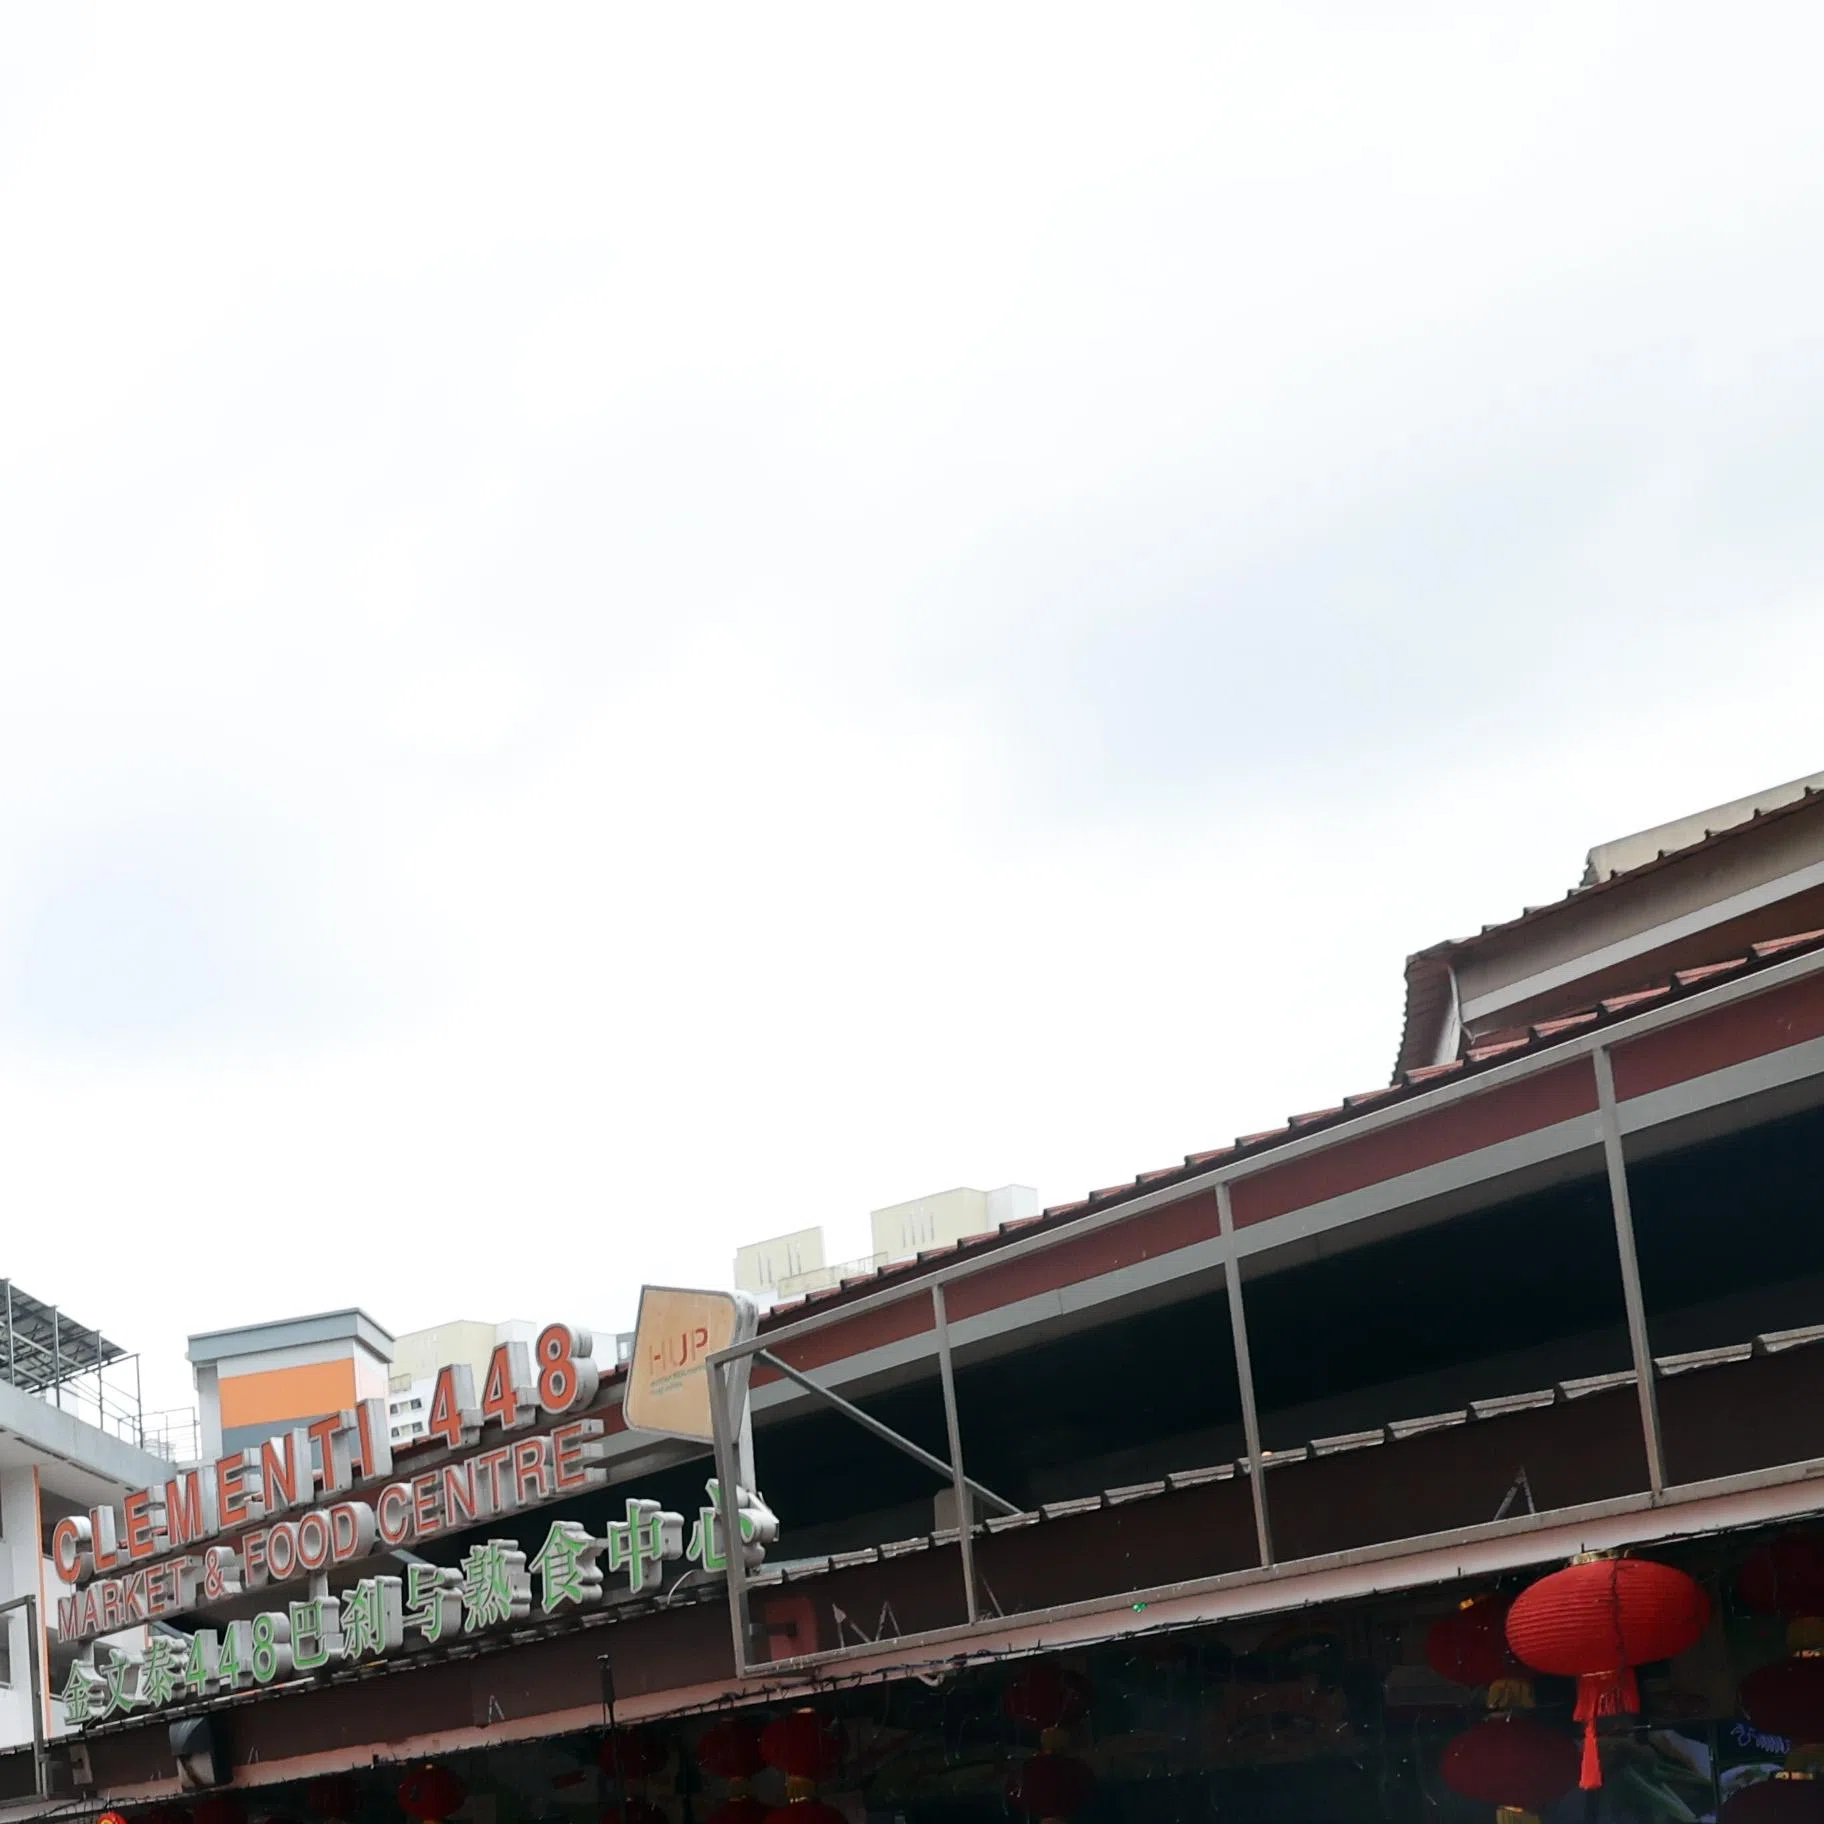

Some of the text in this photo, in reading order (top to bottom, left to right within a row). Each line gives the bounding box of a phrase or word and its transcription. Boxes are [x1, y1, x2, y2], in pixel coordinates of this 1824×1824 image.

[53, 1323, 580, 1584] CLEMENTI 448
[648, 1327, 709, 1375] HUP
[57, 1423, 587, 1644] MARKET & FOOD CENTRE
[61, 1478, 754, 1726] 金文泰448巴刹与熟食中心
